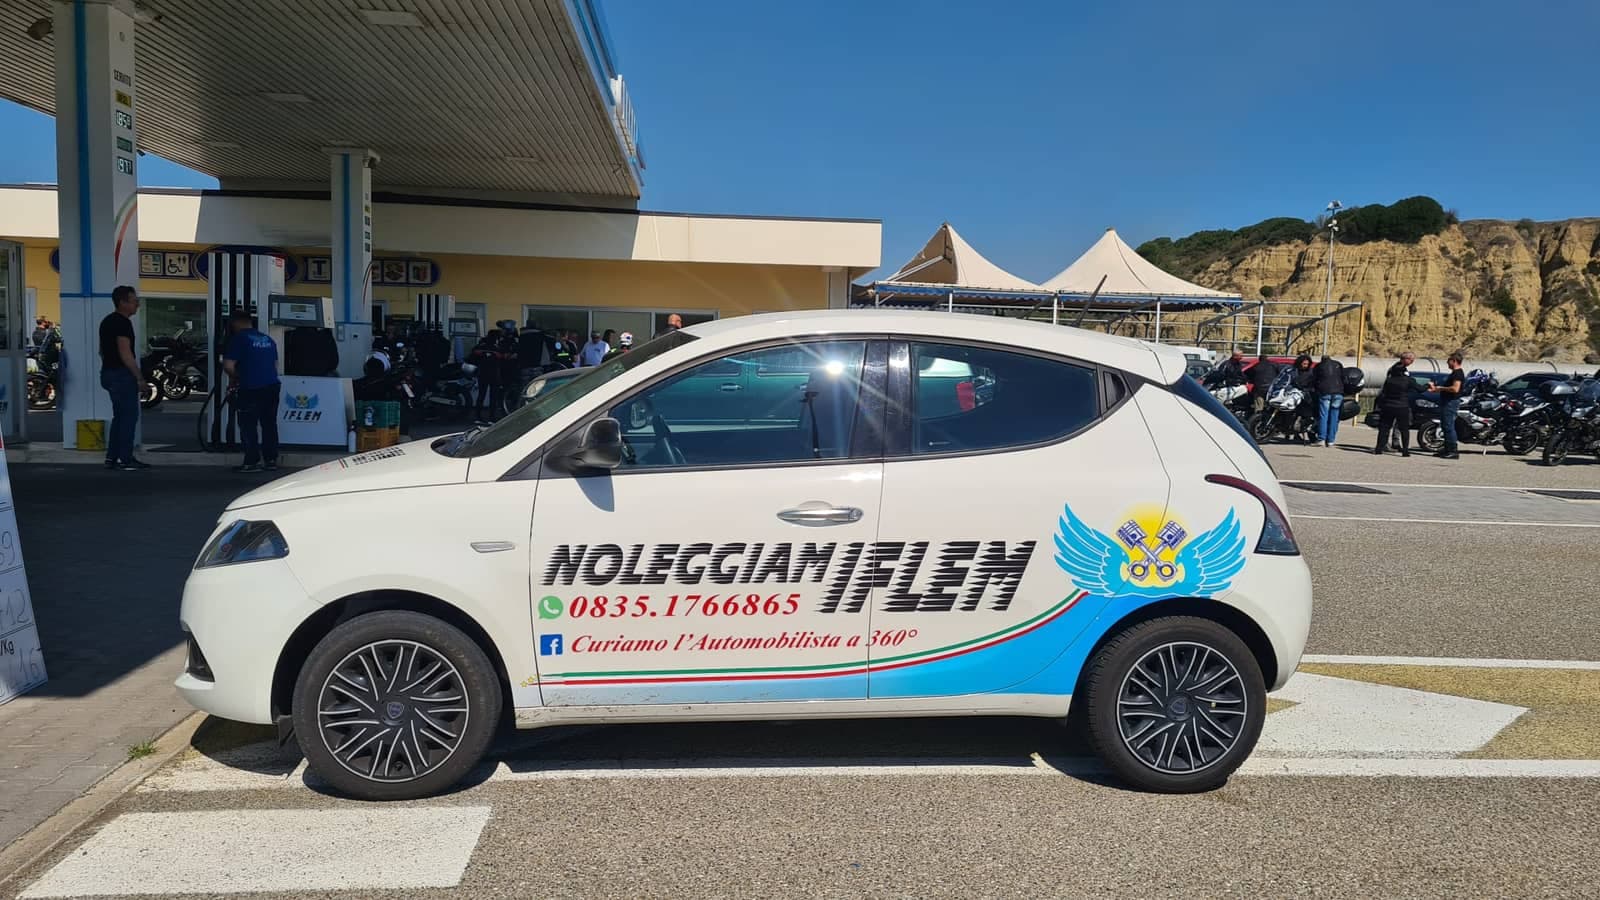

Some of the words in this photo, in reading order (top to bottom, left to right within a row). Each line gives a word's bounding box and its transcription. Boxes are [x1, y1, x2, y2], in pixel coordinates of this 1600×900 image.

[283, 410, 321, 421] IFLEM
[540, 543, 837, 586] NOLEGGIAM
[812, 541, 1037, 614] IFLEM
[569, 593, 800, 618] 0835.1766865
[571, 635, 668, 653] Curiamo
[673, 631, 843, 652] l’Automobilista
[846, 635, 860, 648] a
[867, 628, 918, 648] 360°
